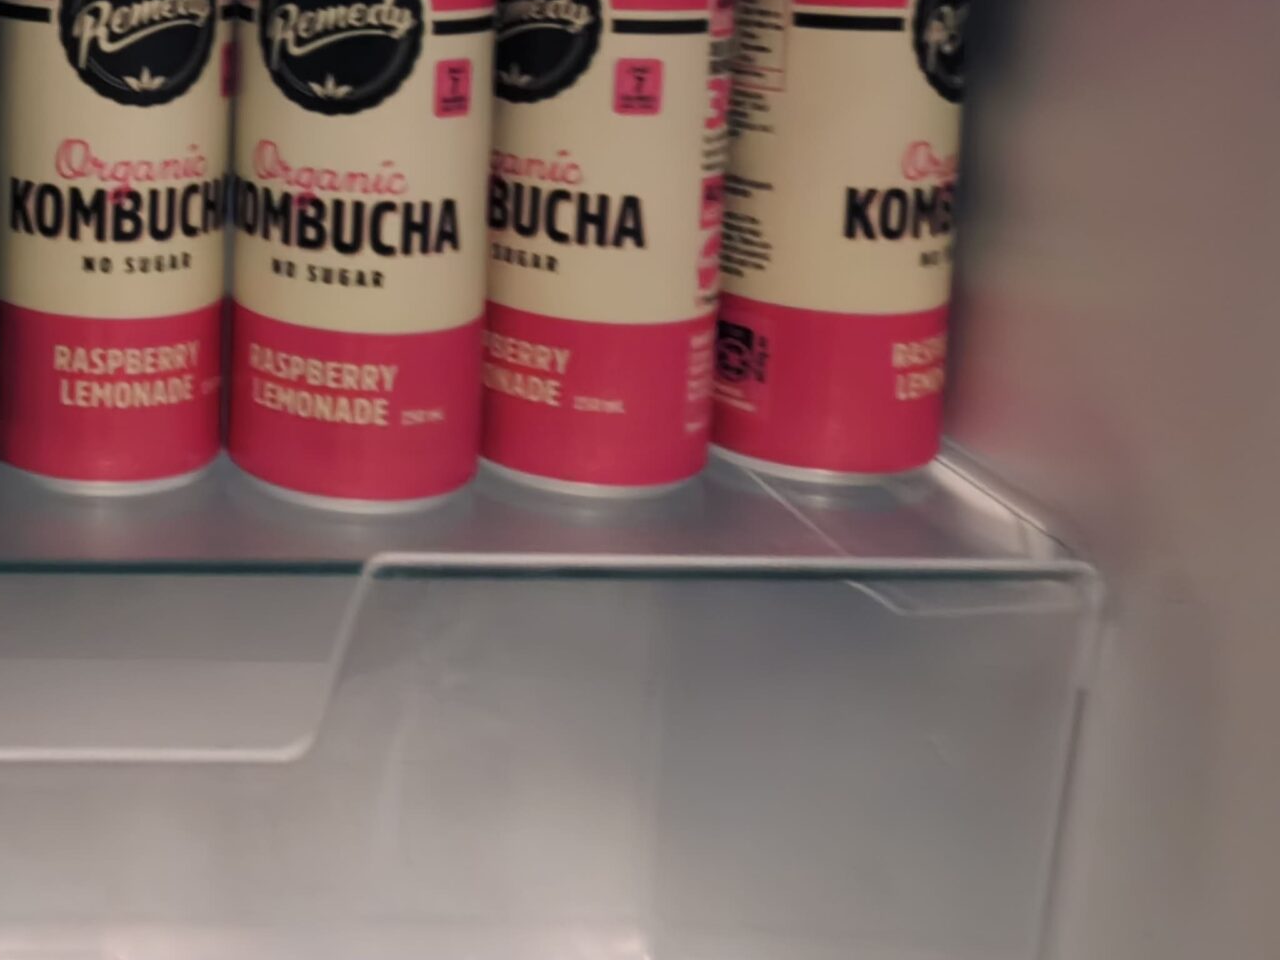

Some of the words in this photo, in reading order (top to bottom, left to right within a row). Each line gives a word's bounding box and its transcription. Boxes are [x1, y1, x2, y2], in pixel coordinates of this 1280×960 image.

[55, 138, 207, 204] Organic
[255, 139, 410, 209] Organic
[488, 173, 646, 251] BUCHA
[81, 255, 113, 274] NO
[124, 251, 192, 275] SUGAR
[271, 257, 297, 280] NO
[307, 264, 386, 289] SUGAR
[53, 341, 201, 376] RASPBERRY
[248, 343, 399, 392] RASPBERRY
[485, 332, 570, 376] BERRY
[59, 374, 196, 409] LEMONADE
[252, 378, 390, 427] LEMONADE
